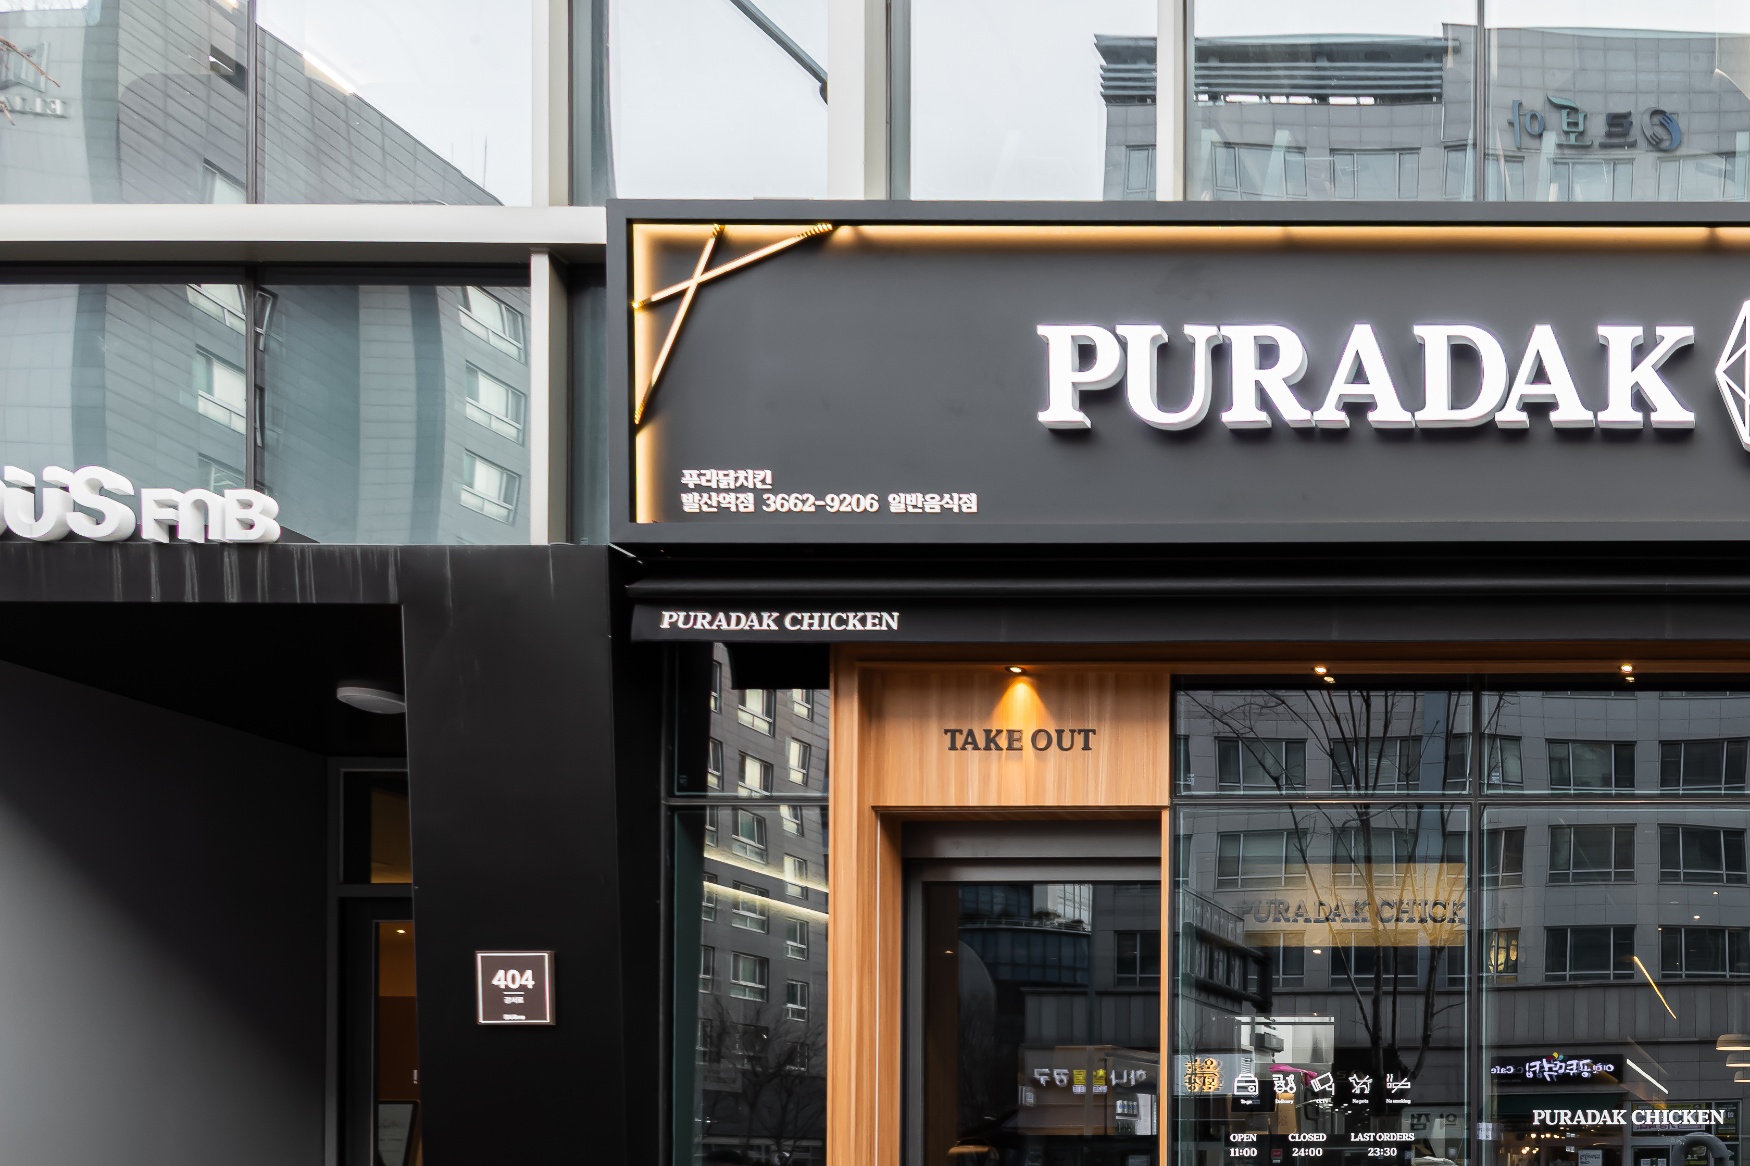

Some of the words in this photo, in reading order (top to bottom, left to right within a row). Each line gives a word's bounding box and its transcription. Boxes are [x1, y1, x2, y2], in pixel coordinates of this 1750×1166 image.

[1036, 323, 1696, 431] PURADAK
[680, 468, 773, 490] 푸라닭치킨
[680, 492, 755, 513] 발산역점
[762, 492, 880, 513] 3662-9206
[887, 492, 978, 513] 일반음식점
[659, 610, 780, 631] PURADAK
[784, 611, 900, 631] CHICKEN
[943, 728, 1024, 751] TAKE
[1030, 728, 1097, 751] OUT
[491, 969, 536, 989] 404
[1532, 1109, 1627, 1126] PURADAK
[1631, 1109, 1725, 1126] CHICKEN
[1229, 1133, 1257, 1142] OPEN
[1288, 1133, 1327, 1142] CLOSED
[1350, 1133, 1375, 1142] LAST
[1376, 1133, 1415, 1142] ORDERS
[1229, 1147, 1258, 1157] 11:00
[1291, 1147, 1323, 1157] 24:00
[1367, 1147, 1398, 1157] 23:30
